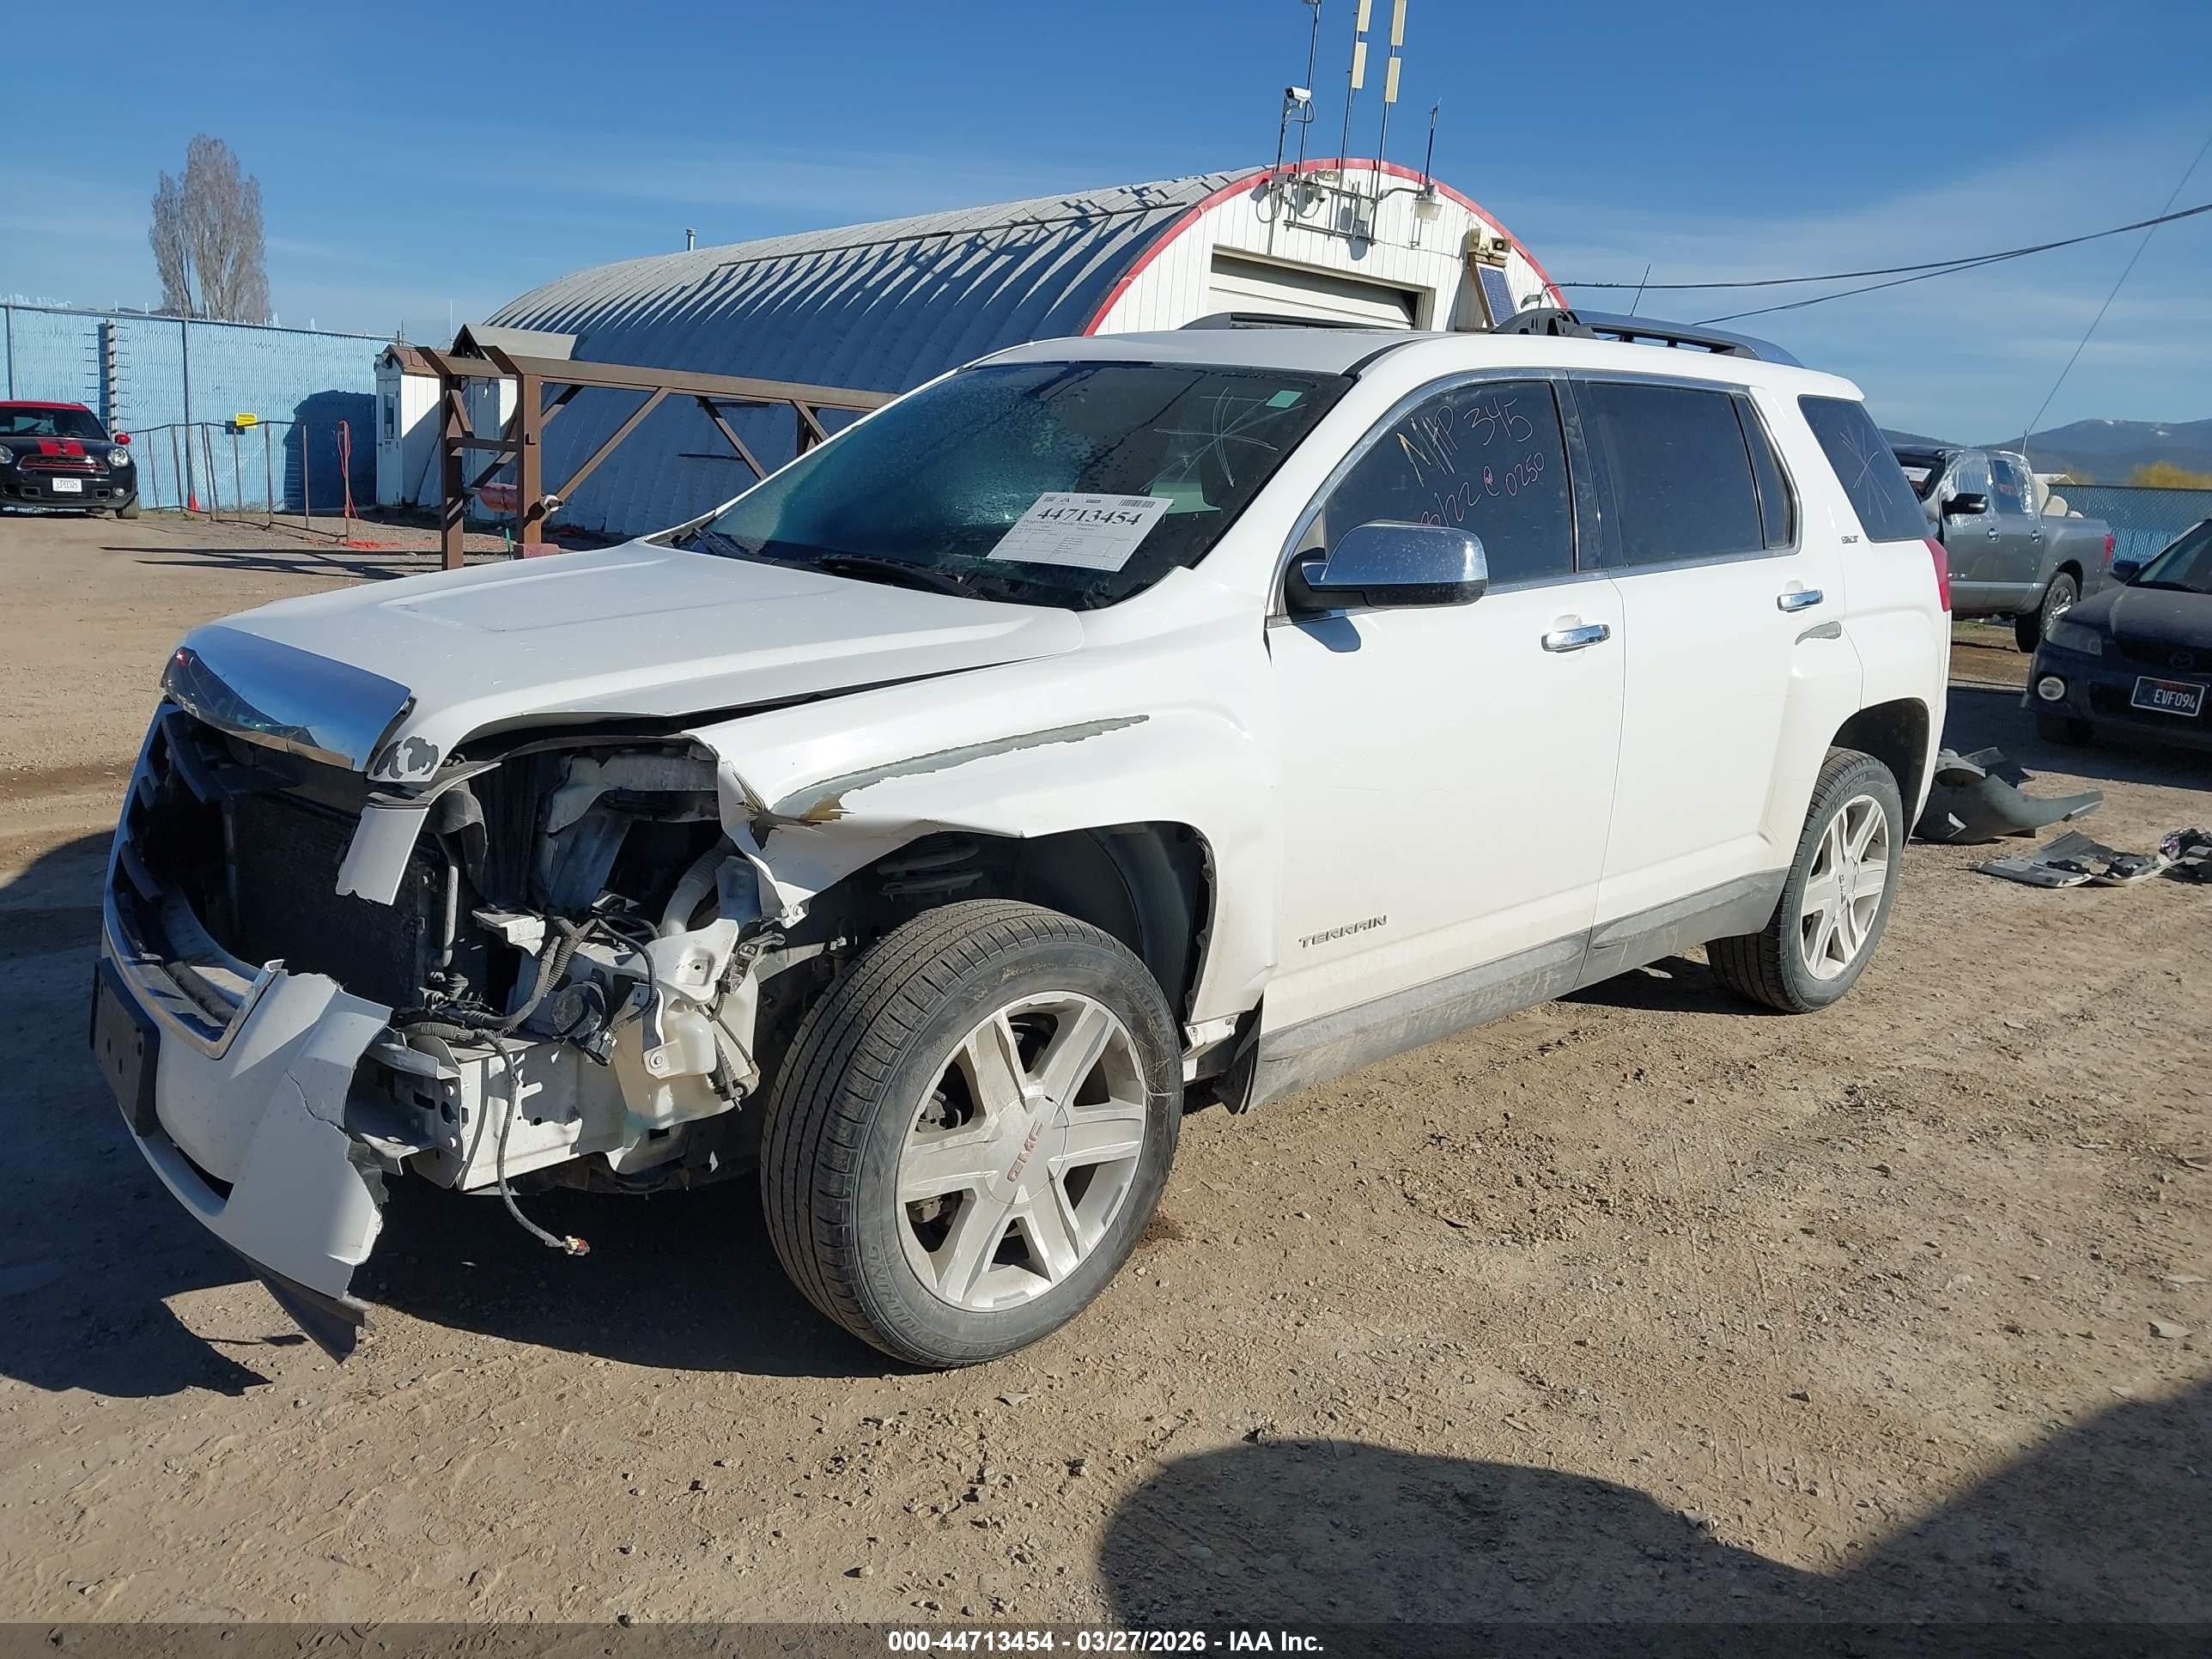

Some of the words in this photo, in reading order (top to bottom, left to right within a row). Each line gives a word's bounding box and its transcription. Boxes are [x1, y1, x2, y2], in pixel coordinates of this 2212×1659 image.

[1462, 397, 1534, 446] 345
[1505, 452, 1545, 496] 0250
[1036, 507, 1144, 526] 44713454
[2153, 689, 2196, 709] EVF094
[1297, 915, 1388, 949] TERRAIN
[1006, 1119, 1044, 1182] GMC
